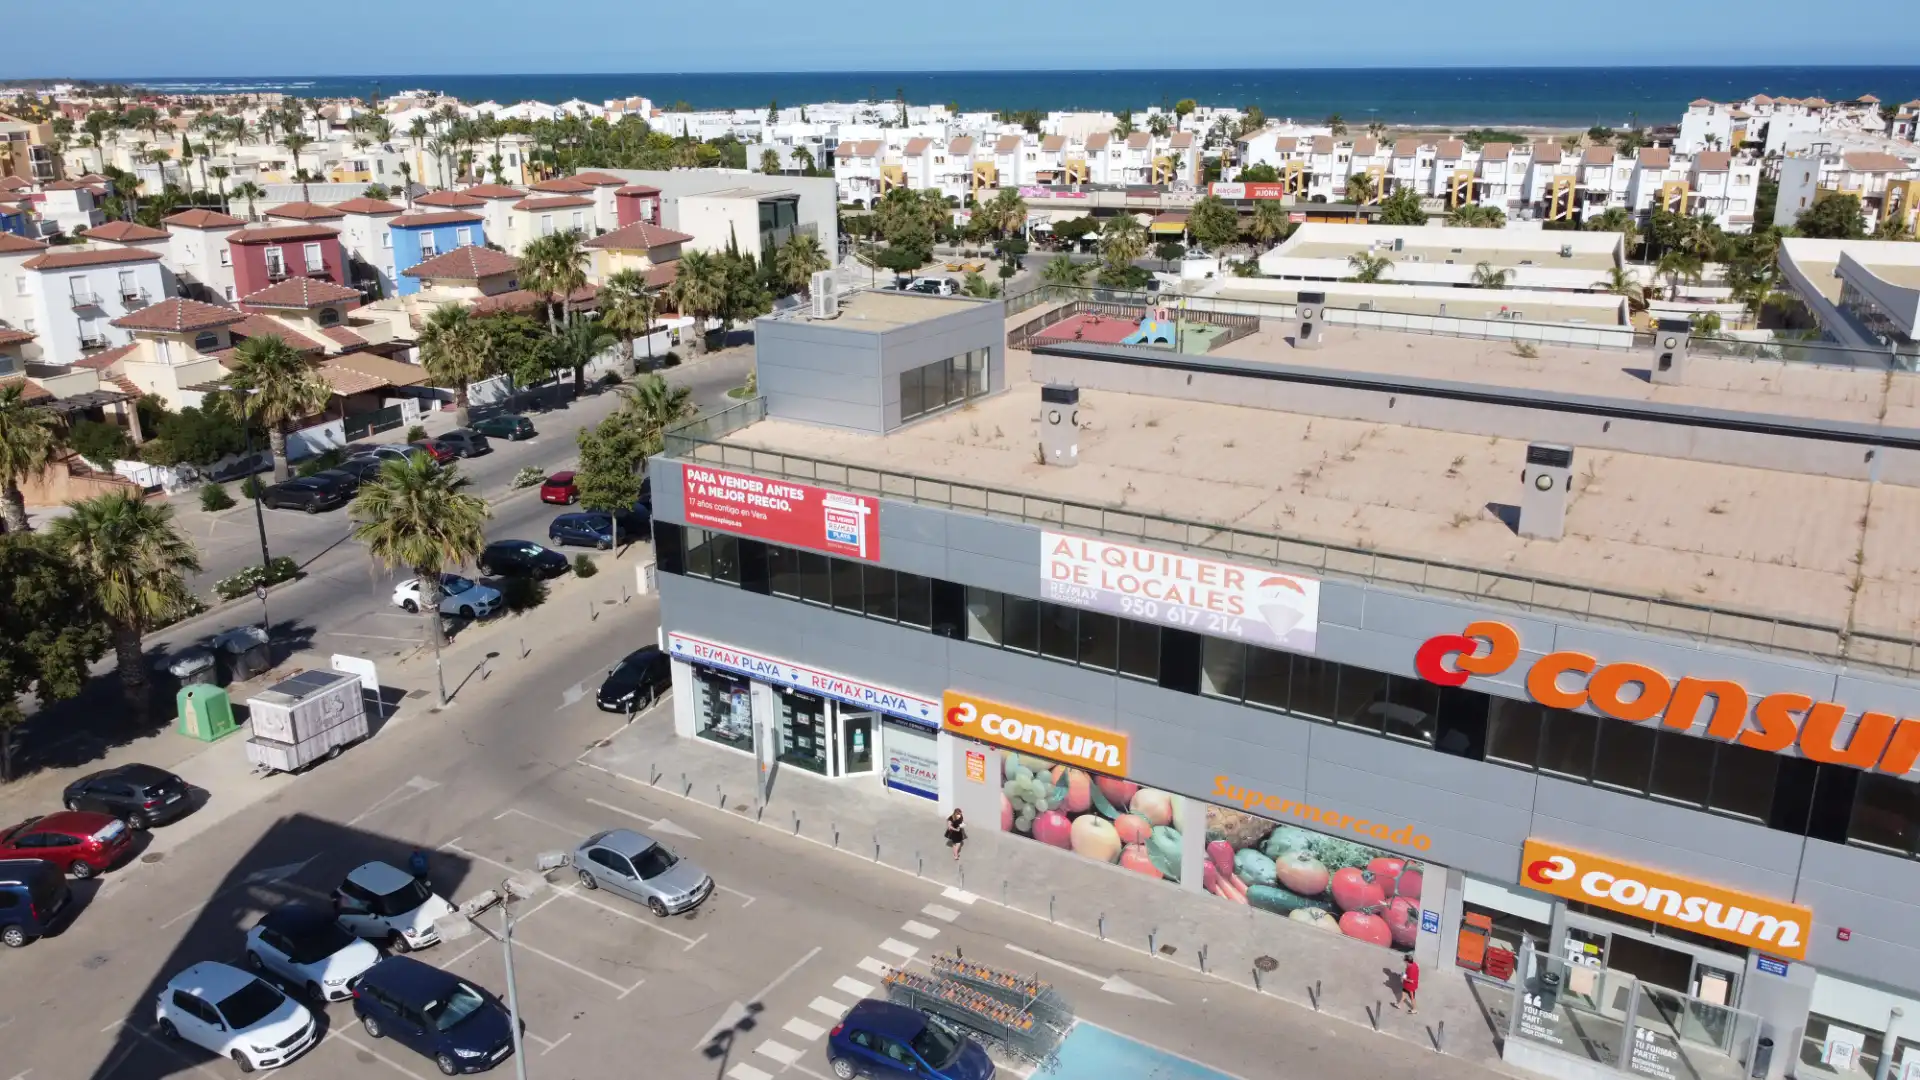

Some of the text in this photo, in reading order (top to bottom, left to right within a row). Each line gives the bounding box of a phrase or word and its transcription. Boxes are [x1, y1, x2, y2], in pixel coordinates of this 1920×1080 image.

[687, 469, 804, 501] PARA VENDER ANTES
[688, 482, 792, 512] Y A MEJOR PRECIO.
[689, 497, 767, 520] 17 años contigo en Vera
[1052, 538, 1245, 591] ALQUILER
[1050, 581, 1098, 601] RE/MAX
[1051, 561, 1245, 615] DE LOCALES
[1120, 596, 1243, 636] 950 617 214
[694, 644, 739, 666] RE/MAX
[742, 657, 780, 677] PLAYA
[812, 675, 861, 698] RE/MAX
[865, 689, 907, 711] PLAYA
[981, 713, 1121, 767] consum
[904, 764, 937, 781] RE/MAX
[1211, 775, 1432, 852] Supermercado
[1580, 871, 1800, 947] consum
[1523, 1004, 1559, 1022] YOU FORM
[1635, 1040, 1678, 1060] TU FORMAS
